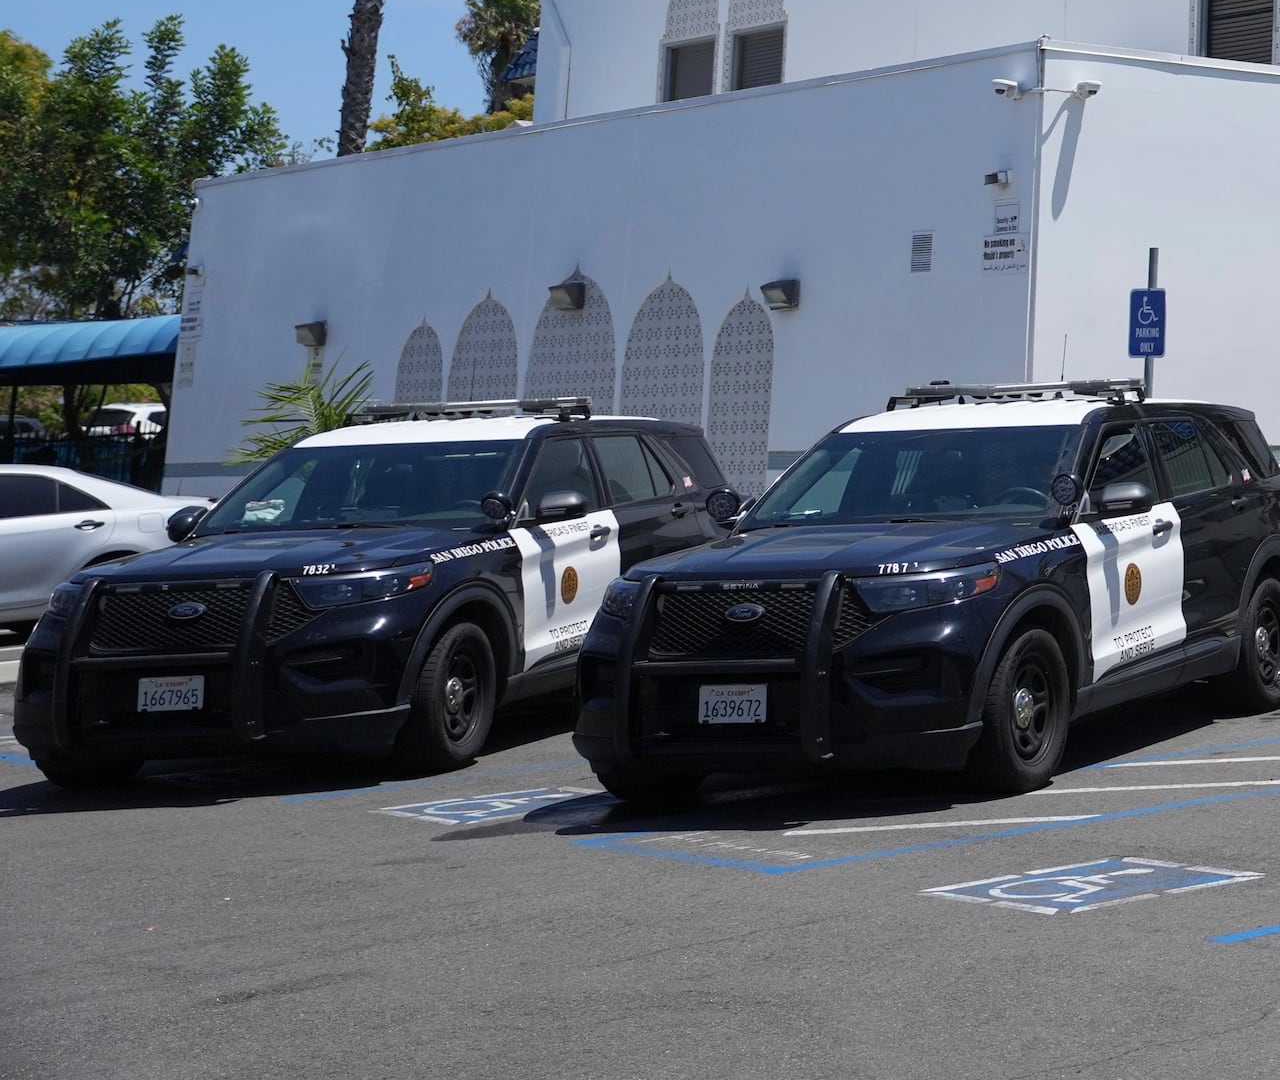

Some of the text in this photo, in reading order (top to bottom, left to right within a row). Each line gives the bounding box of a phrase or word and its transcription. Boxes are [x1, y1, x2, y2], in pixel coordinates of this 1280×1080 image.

[1135, 327, 1160, 338] PARKING
[1140, 342, 1155, 352] ONLY
[430, 537, 516, 564] SAN DIEGO POLICE
[994, 533, 1080, 564] SAN DIEGO POLICE
[303, 563, 330, 576] 7832
[549, 620, 588, 639] TO PROTECT
[1113, 625, 1154, 649] TO PROTECT
[570, 633, 587, 648] SERV
[1120, 639, 1155, 662] AND SERVE
[142, 689, 199, 707] 1667965
[704, 700, 761, 718] 1639672
